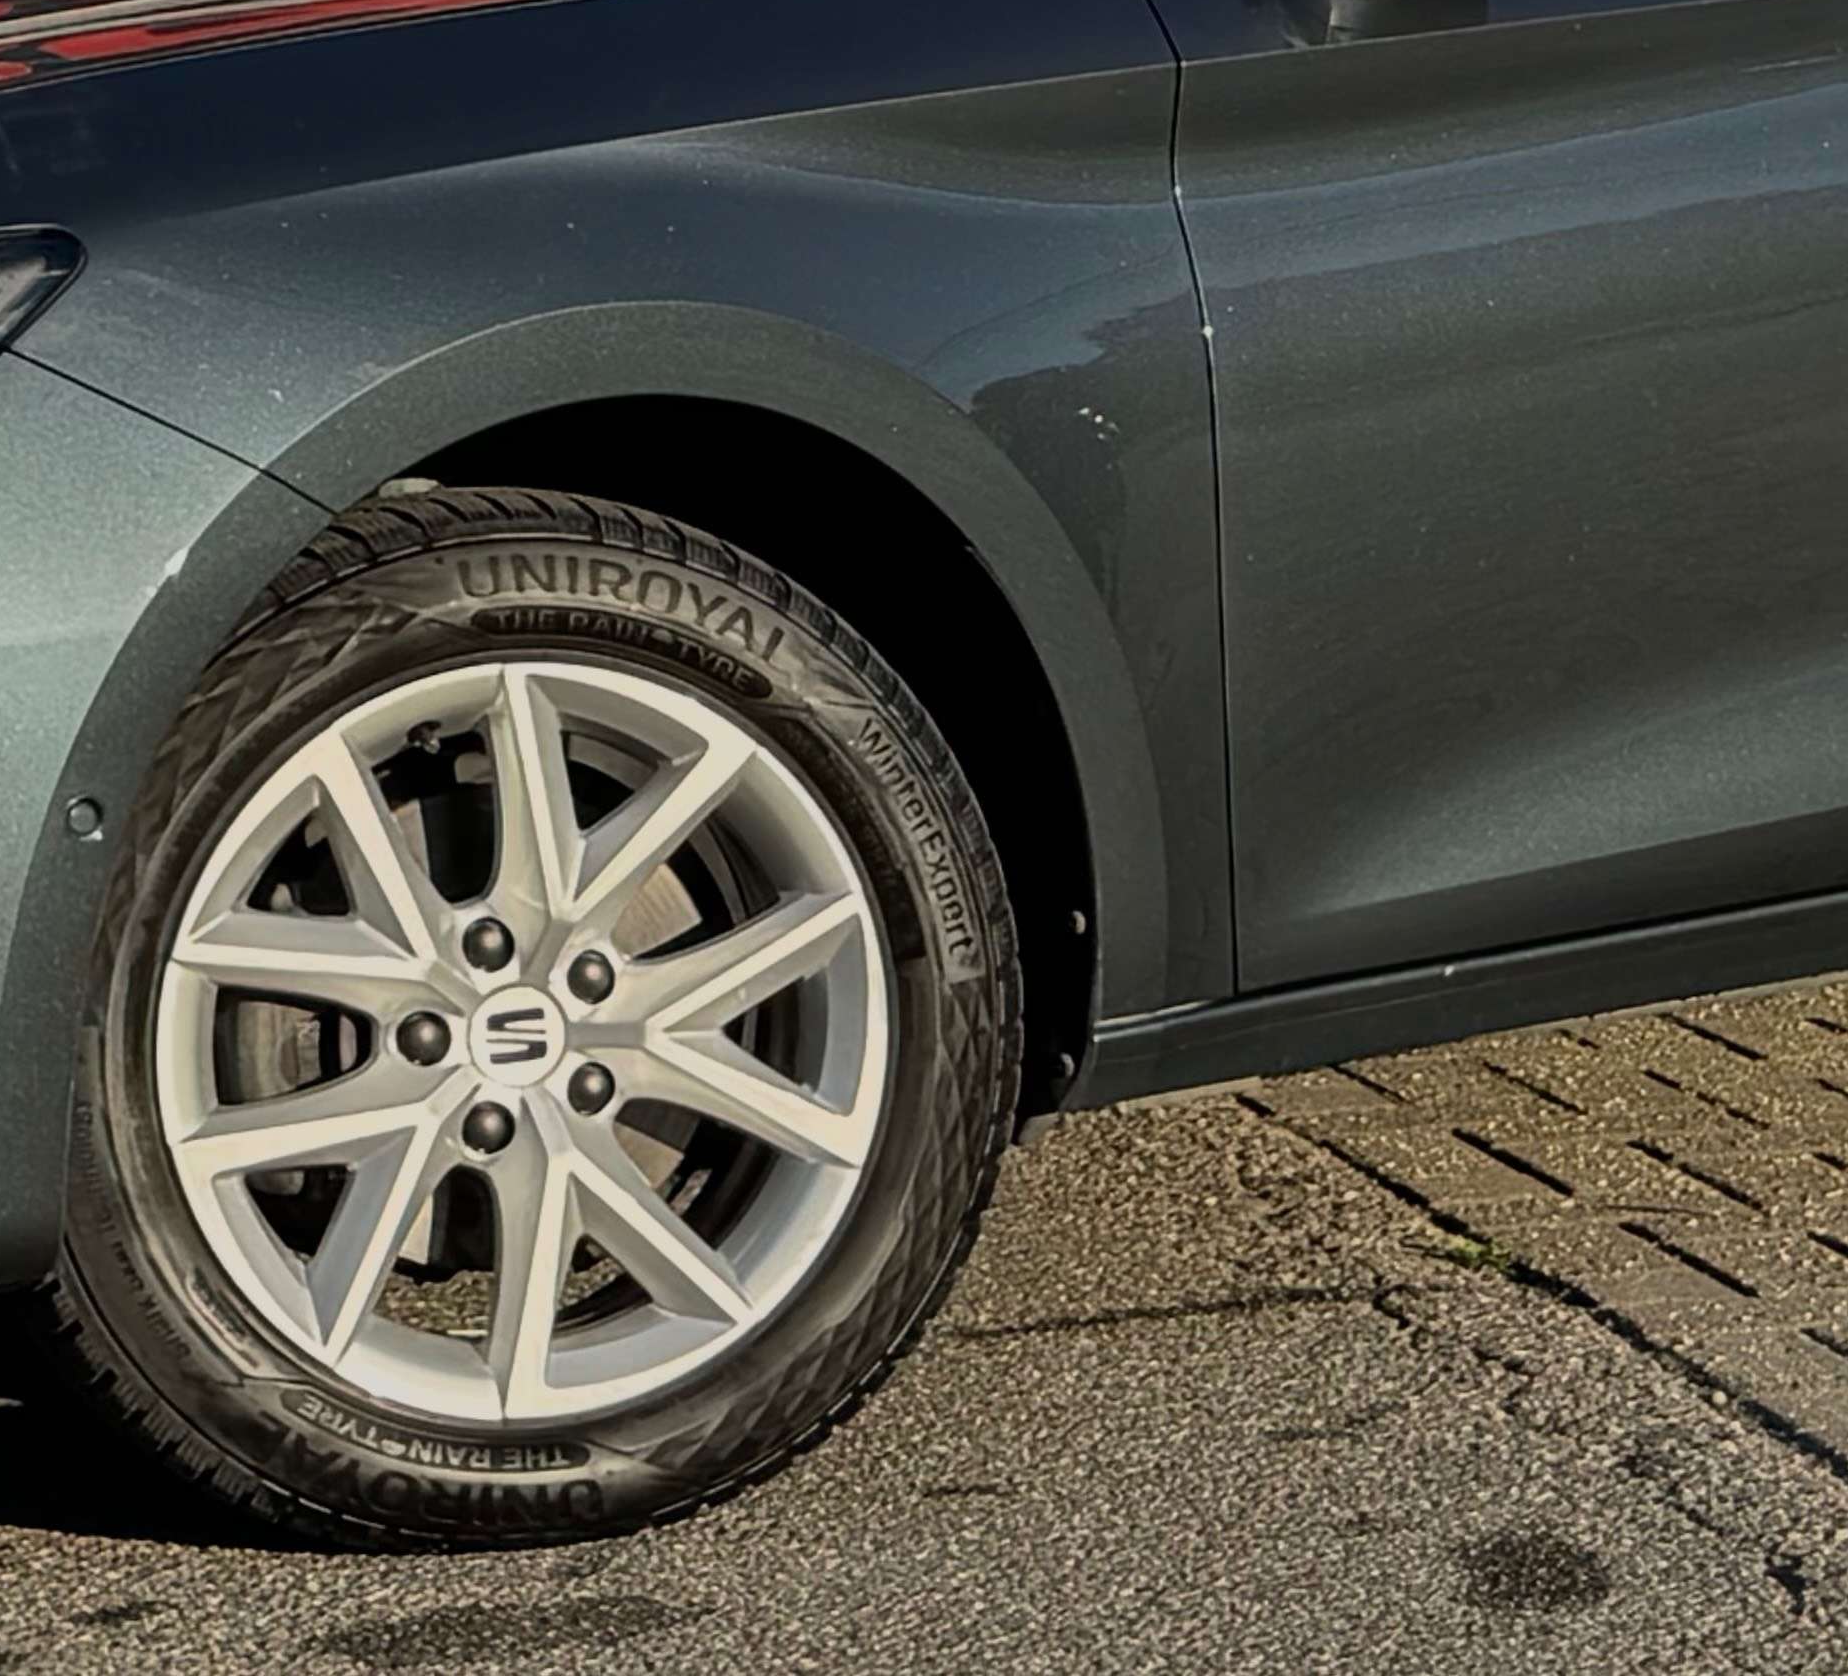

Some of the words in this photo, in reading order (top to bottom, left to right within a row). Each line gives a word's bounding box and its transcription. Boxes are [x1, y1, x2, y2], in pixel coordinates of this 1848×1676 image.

[456, 553, 785, 664] UNIROYAL
[857, 716, 975, 956] WinterExpert
[296, 1394, 379, 1451] TYRE
[407, 1438, 493, 1469] RAIN
